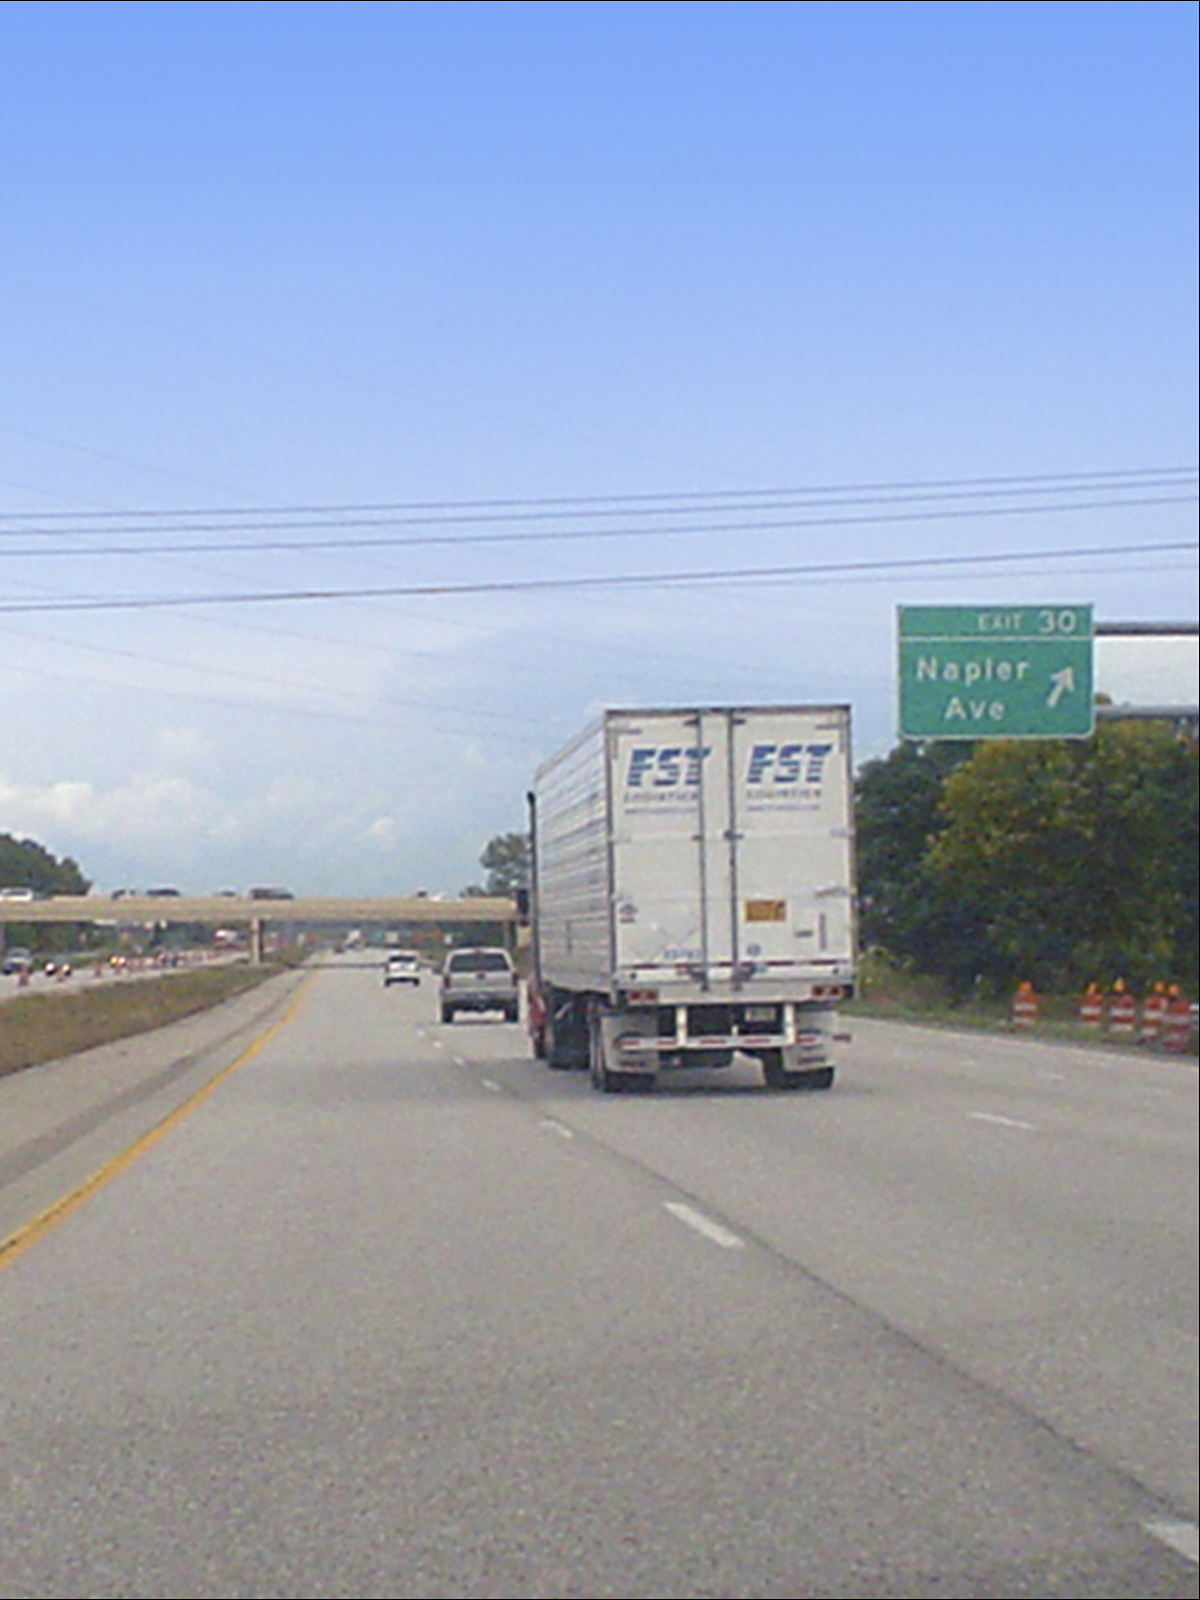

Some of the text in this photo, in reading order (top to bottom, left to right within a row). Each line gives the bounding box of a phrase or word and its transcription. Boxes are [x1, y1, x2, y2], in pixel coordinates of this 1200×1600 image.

[978, 610, 1076, 632] EXIT 30
[916, 656, 1030, 686] Napier
[944, 697, 1005, 720] Ave
[627, 748, 712, 787] FST
[746, 744, 833, 783] FST
